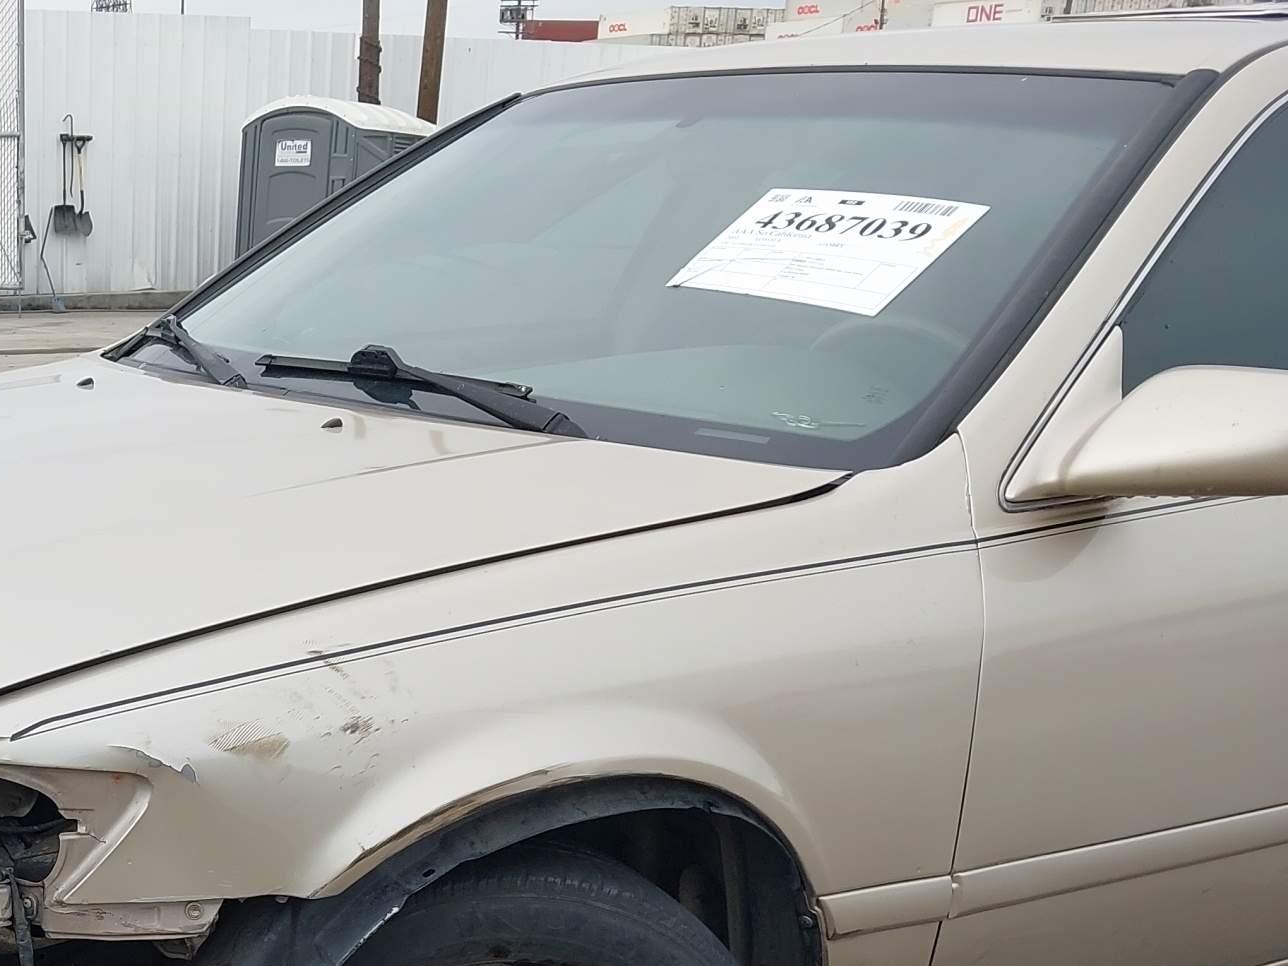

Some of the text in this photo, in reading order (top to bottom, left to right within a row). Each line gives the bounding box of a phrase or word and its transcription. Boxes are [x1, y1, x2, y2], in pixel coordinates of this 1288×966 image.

[966, 4, 1005, 23] ONE
[281, 140, 308, 151] United
[755, 210, 933, 242] 43687039
